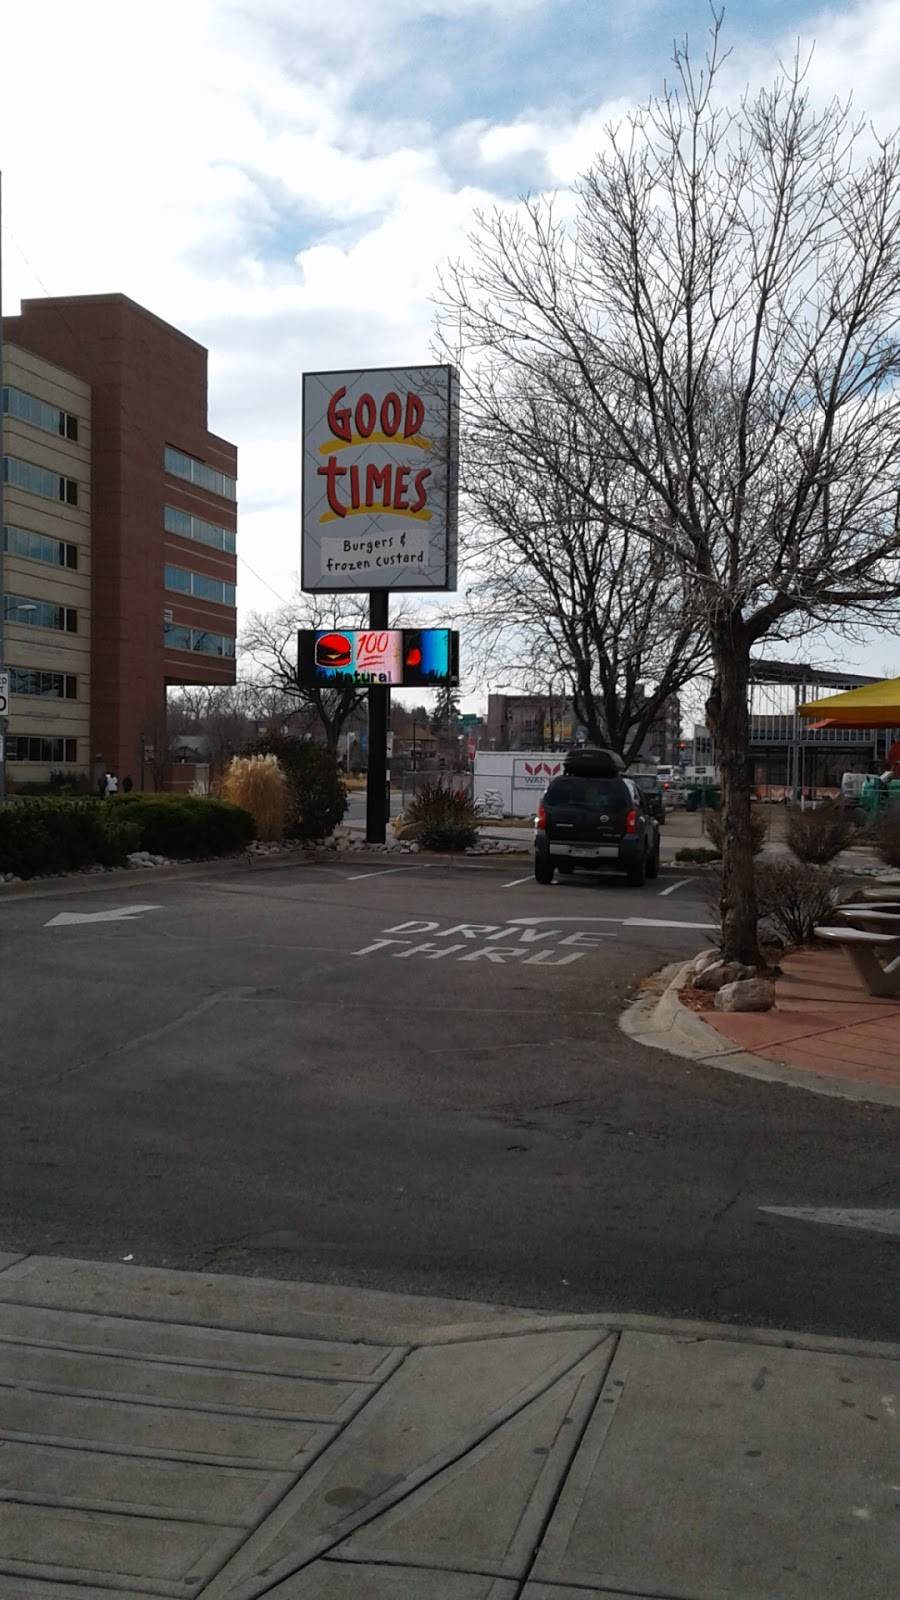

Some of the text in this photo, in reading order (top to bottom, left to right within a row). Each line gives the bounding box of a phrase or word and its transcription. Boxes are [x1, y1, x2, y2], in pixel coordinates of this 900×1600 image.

[327, 385, 425, 443] GOOD
[343, 537, 394, 554] Burgers
[357, 632, 389, 660] 100
[382, 920, 618, 947] DRIVE
[351, 938, 587, 966] THRU
